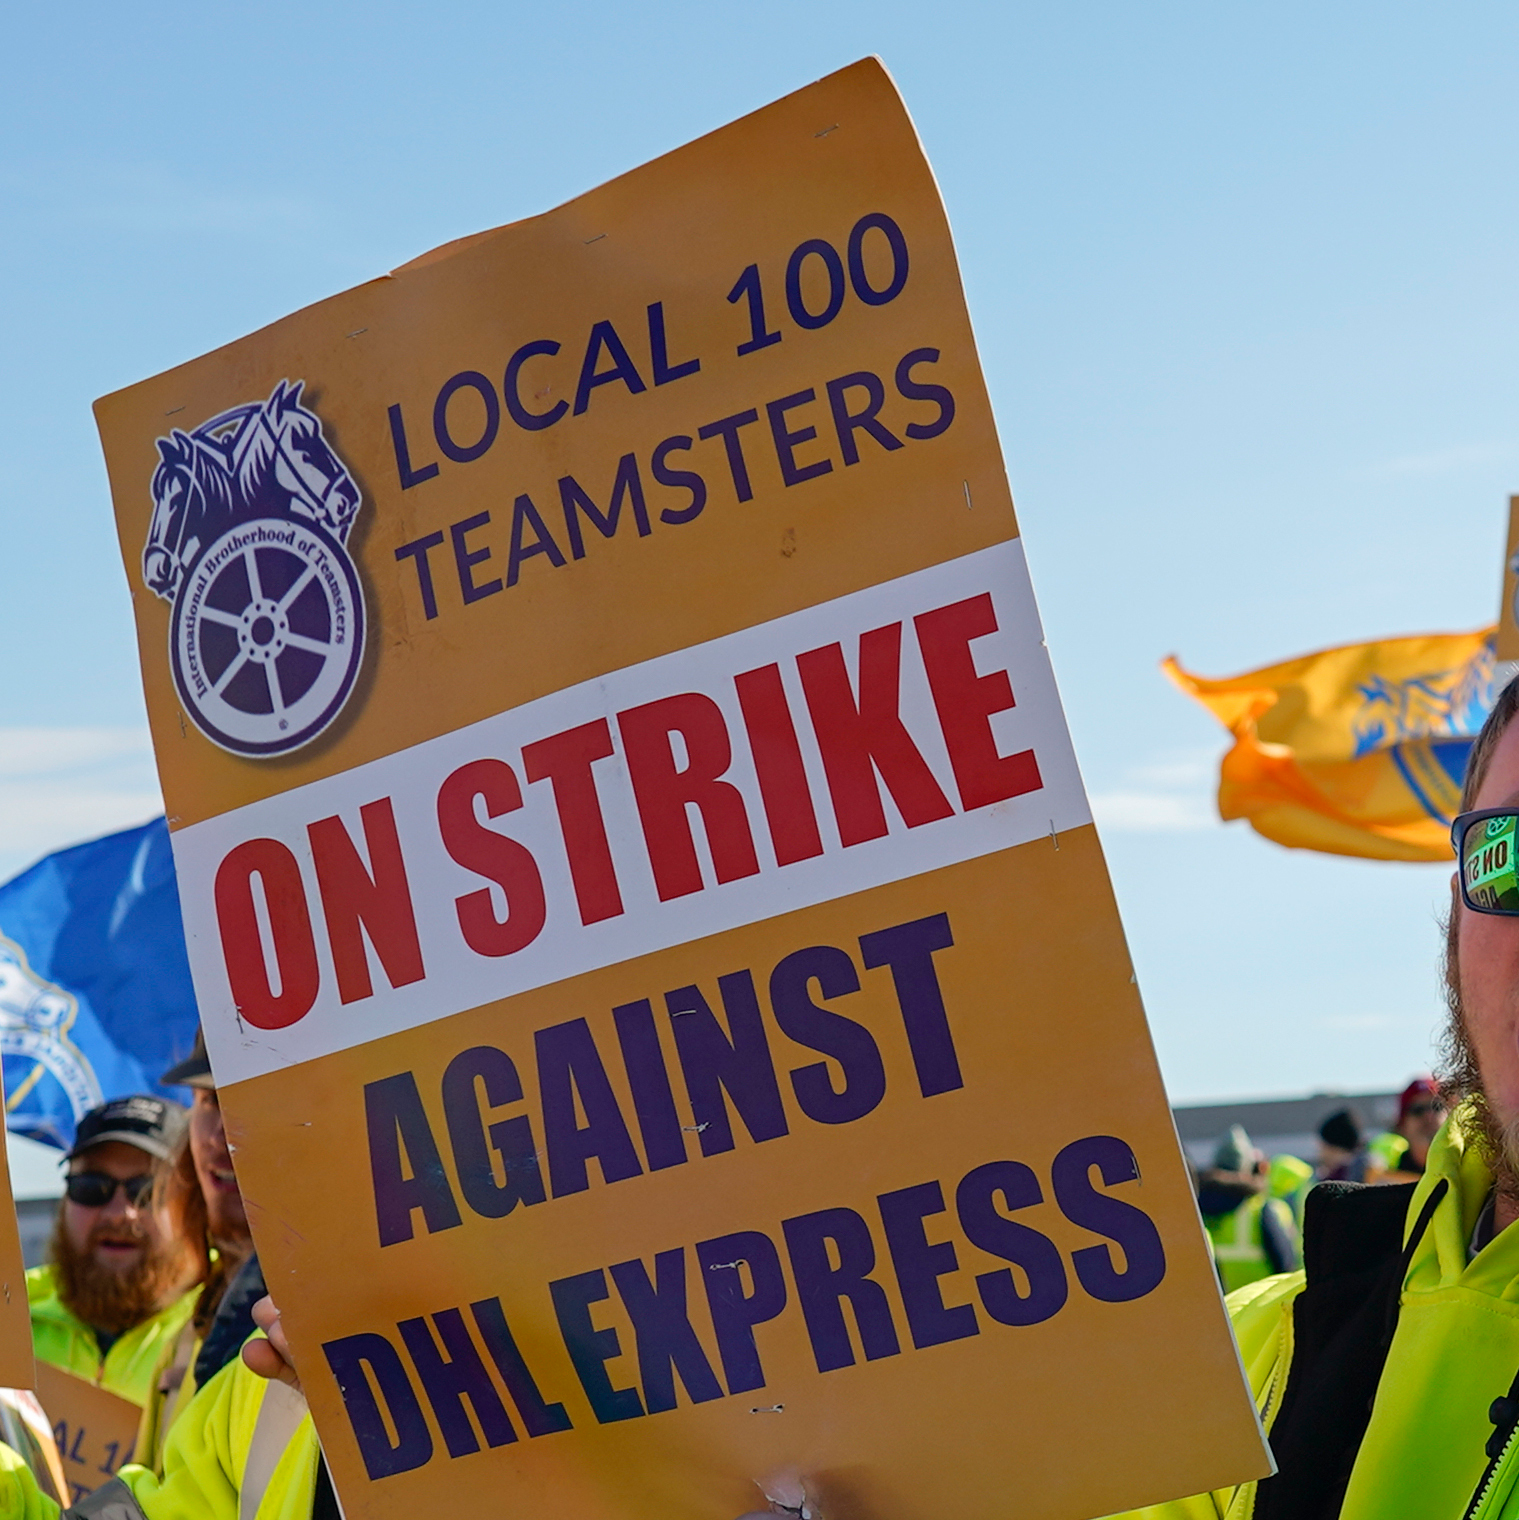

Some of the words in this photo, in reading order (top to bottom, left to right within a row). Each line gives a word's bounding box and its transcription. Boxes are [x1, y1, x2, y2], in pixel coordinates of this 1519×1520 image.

[387, 301, 701, 491] LOCAL
[726, 213, 909, 357] 100
[394, 347, 955, 621] TEAMSTERS
[185, 574, 209, 700] International
[204, 525, 296, 575] Brotherhood
[297, 538, 316, 559] of
[313, 549, 346, 646] Teamsters
[214, 795, 426, 1031] ON
[436, 591, 1044, 958] STRIKE
[363, 912, 964, 1247] AGAINST
[321, 1296, 573, 1482] DHL
[549, 1135, 1167, 1425] EXPRESS
